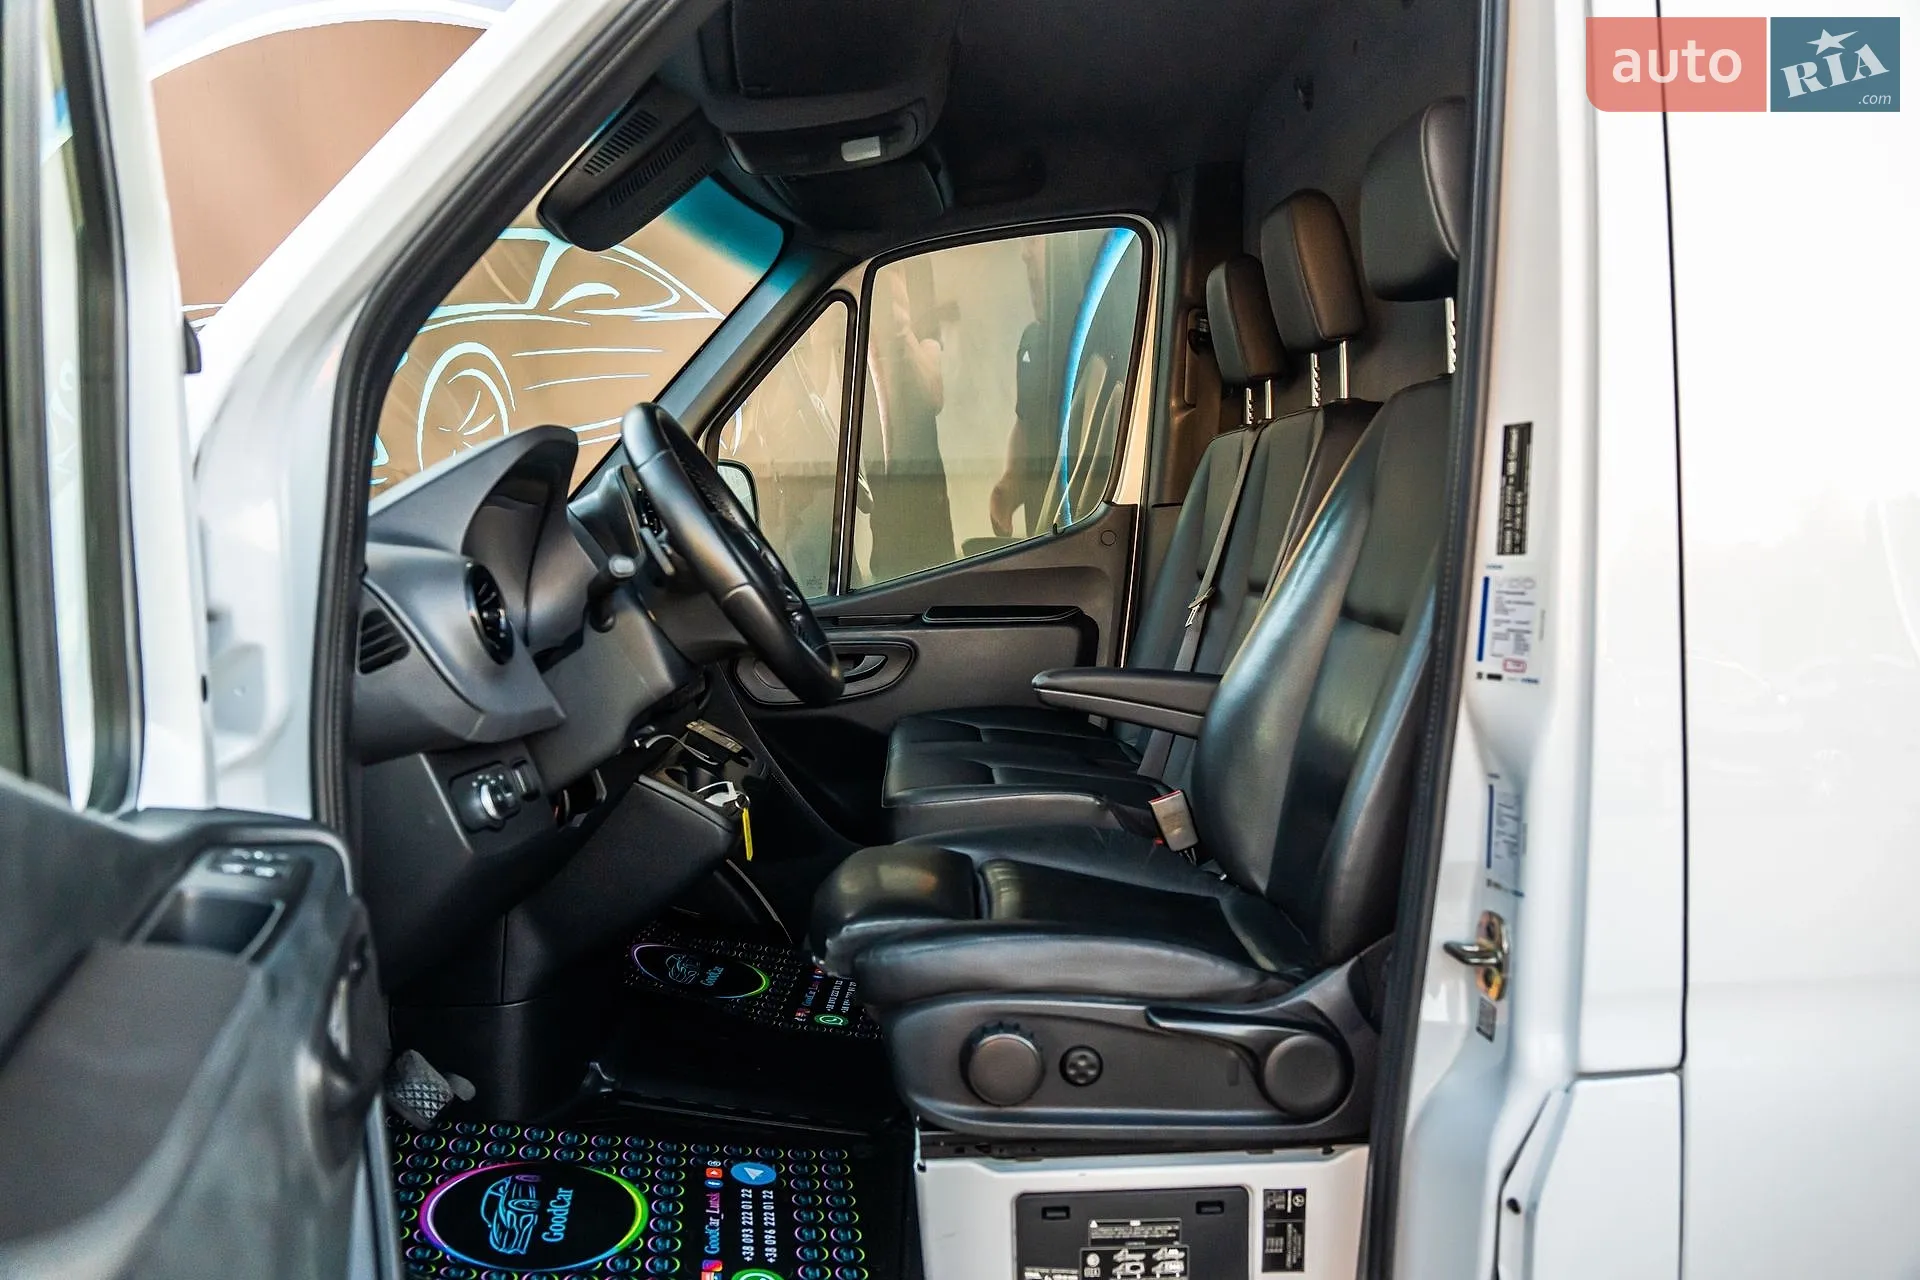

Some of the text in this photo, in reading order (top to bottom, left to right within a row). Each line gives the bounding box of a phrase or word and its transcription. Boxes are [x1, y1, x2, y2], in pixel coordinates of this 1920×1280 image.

[541, 1187, 574, 1242] GoodCar
[740, 1188, 755, 1262] +38 093 222 01 22
[762, 1190, 777, 1263] +38 096 222 01 22
